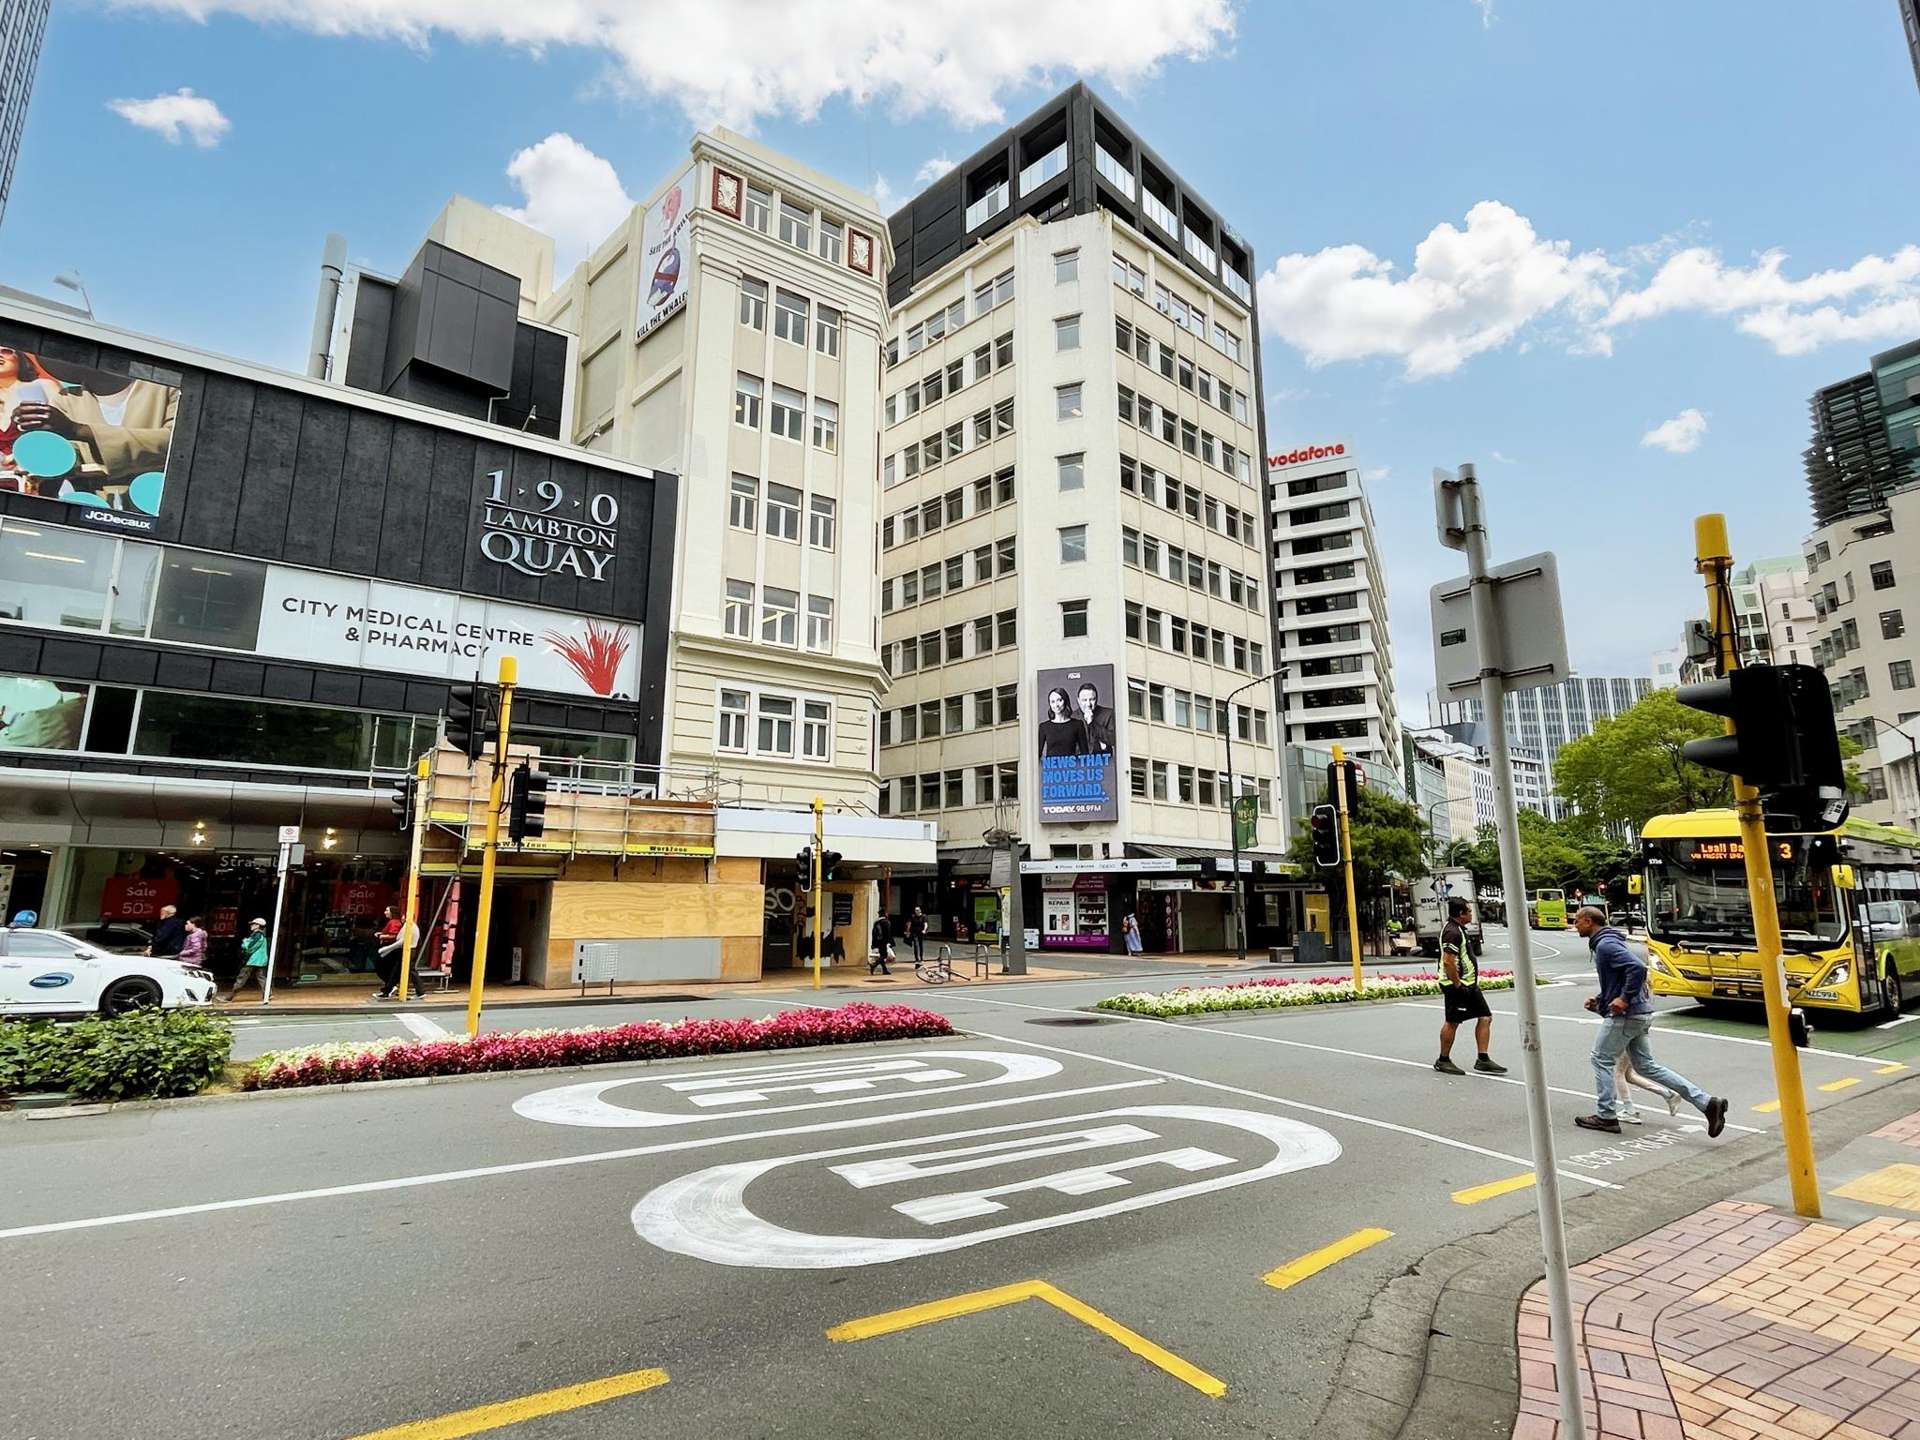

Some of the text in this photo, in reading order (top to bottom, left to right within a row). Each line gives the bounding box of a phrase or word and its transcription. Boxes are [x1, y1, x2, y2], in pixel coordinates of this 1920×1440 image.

[637, 323, 649, 339] KILL
[650, 311, 661, 328] THE
[1268, 443, 1345, 467] vodafone
[85, 510, 151, 529] JCDecaux
[484, 507, 617, 549] LAMBTON
[480, 531, 616, 581] QUAY
[282, 597, 534, 646] CITY MEDICAL CENTRE
[345, 627, 489, 658] & PHARMACY
[1041, 753, 1111, 769] NEWS THAT
[1042, 769, 1104, 784] MOVES US
[1042, 783, 1106, 798] FORWARD.
[1700, 843, 1793, 859] Lyall Ba 3
[127, 887, 157, 897] Sale
[349, 889, 375, 898] Sale
[1558, 1129, 1688, 1170] LOOK RIGHT
